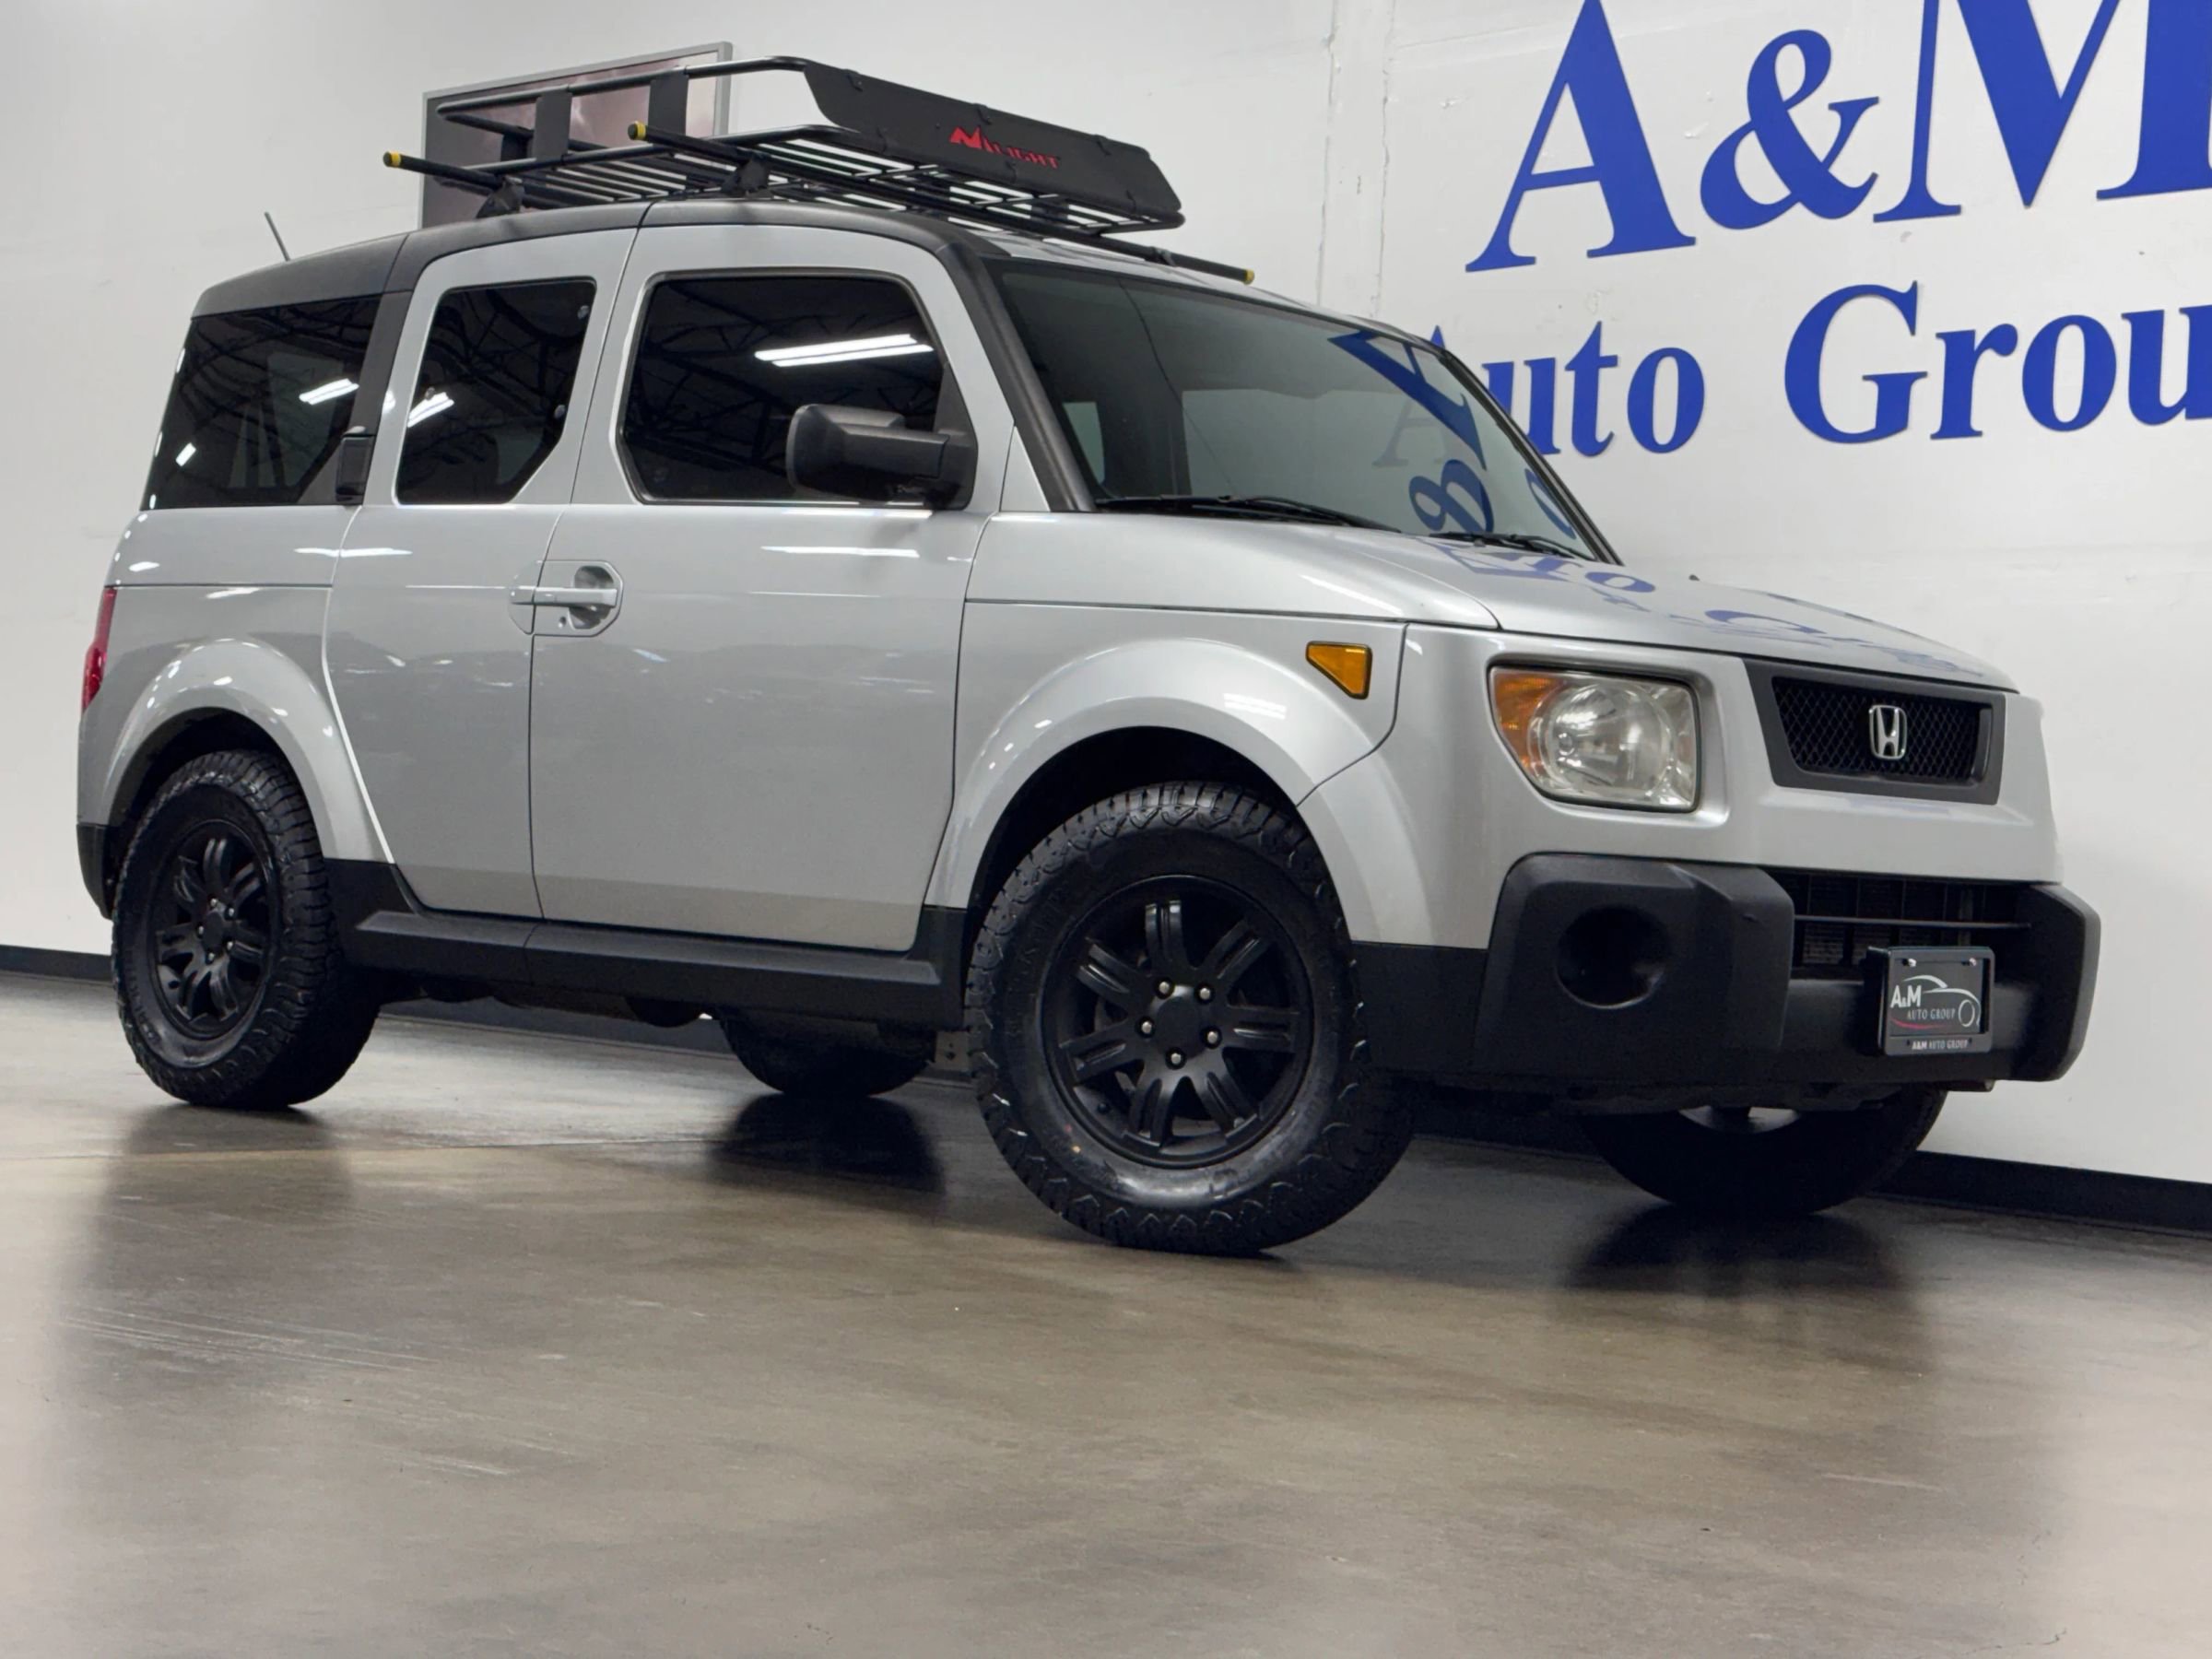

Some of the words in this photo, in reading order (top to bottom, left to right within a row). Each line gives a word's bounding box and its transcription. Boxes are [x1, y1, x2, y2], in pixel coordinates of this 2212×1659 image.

[1465, 0, 2212, 271] A&M
[1889, 984, 1923, 1008] A&M
[1907, 1009, 1928, 1020] AUTO
[1930, 1008, 1956, 1019] GROUP
[1912, 1041, 1927, 1050] A&M
[1929, 1041, 1946, 1050] AUTO
[1947, 1040, 1968, 1049] GROUP
